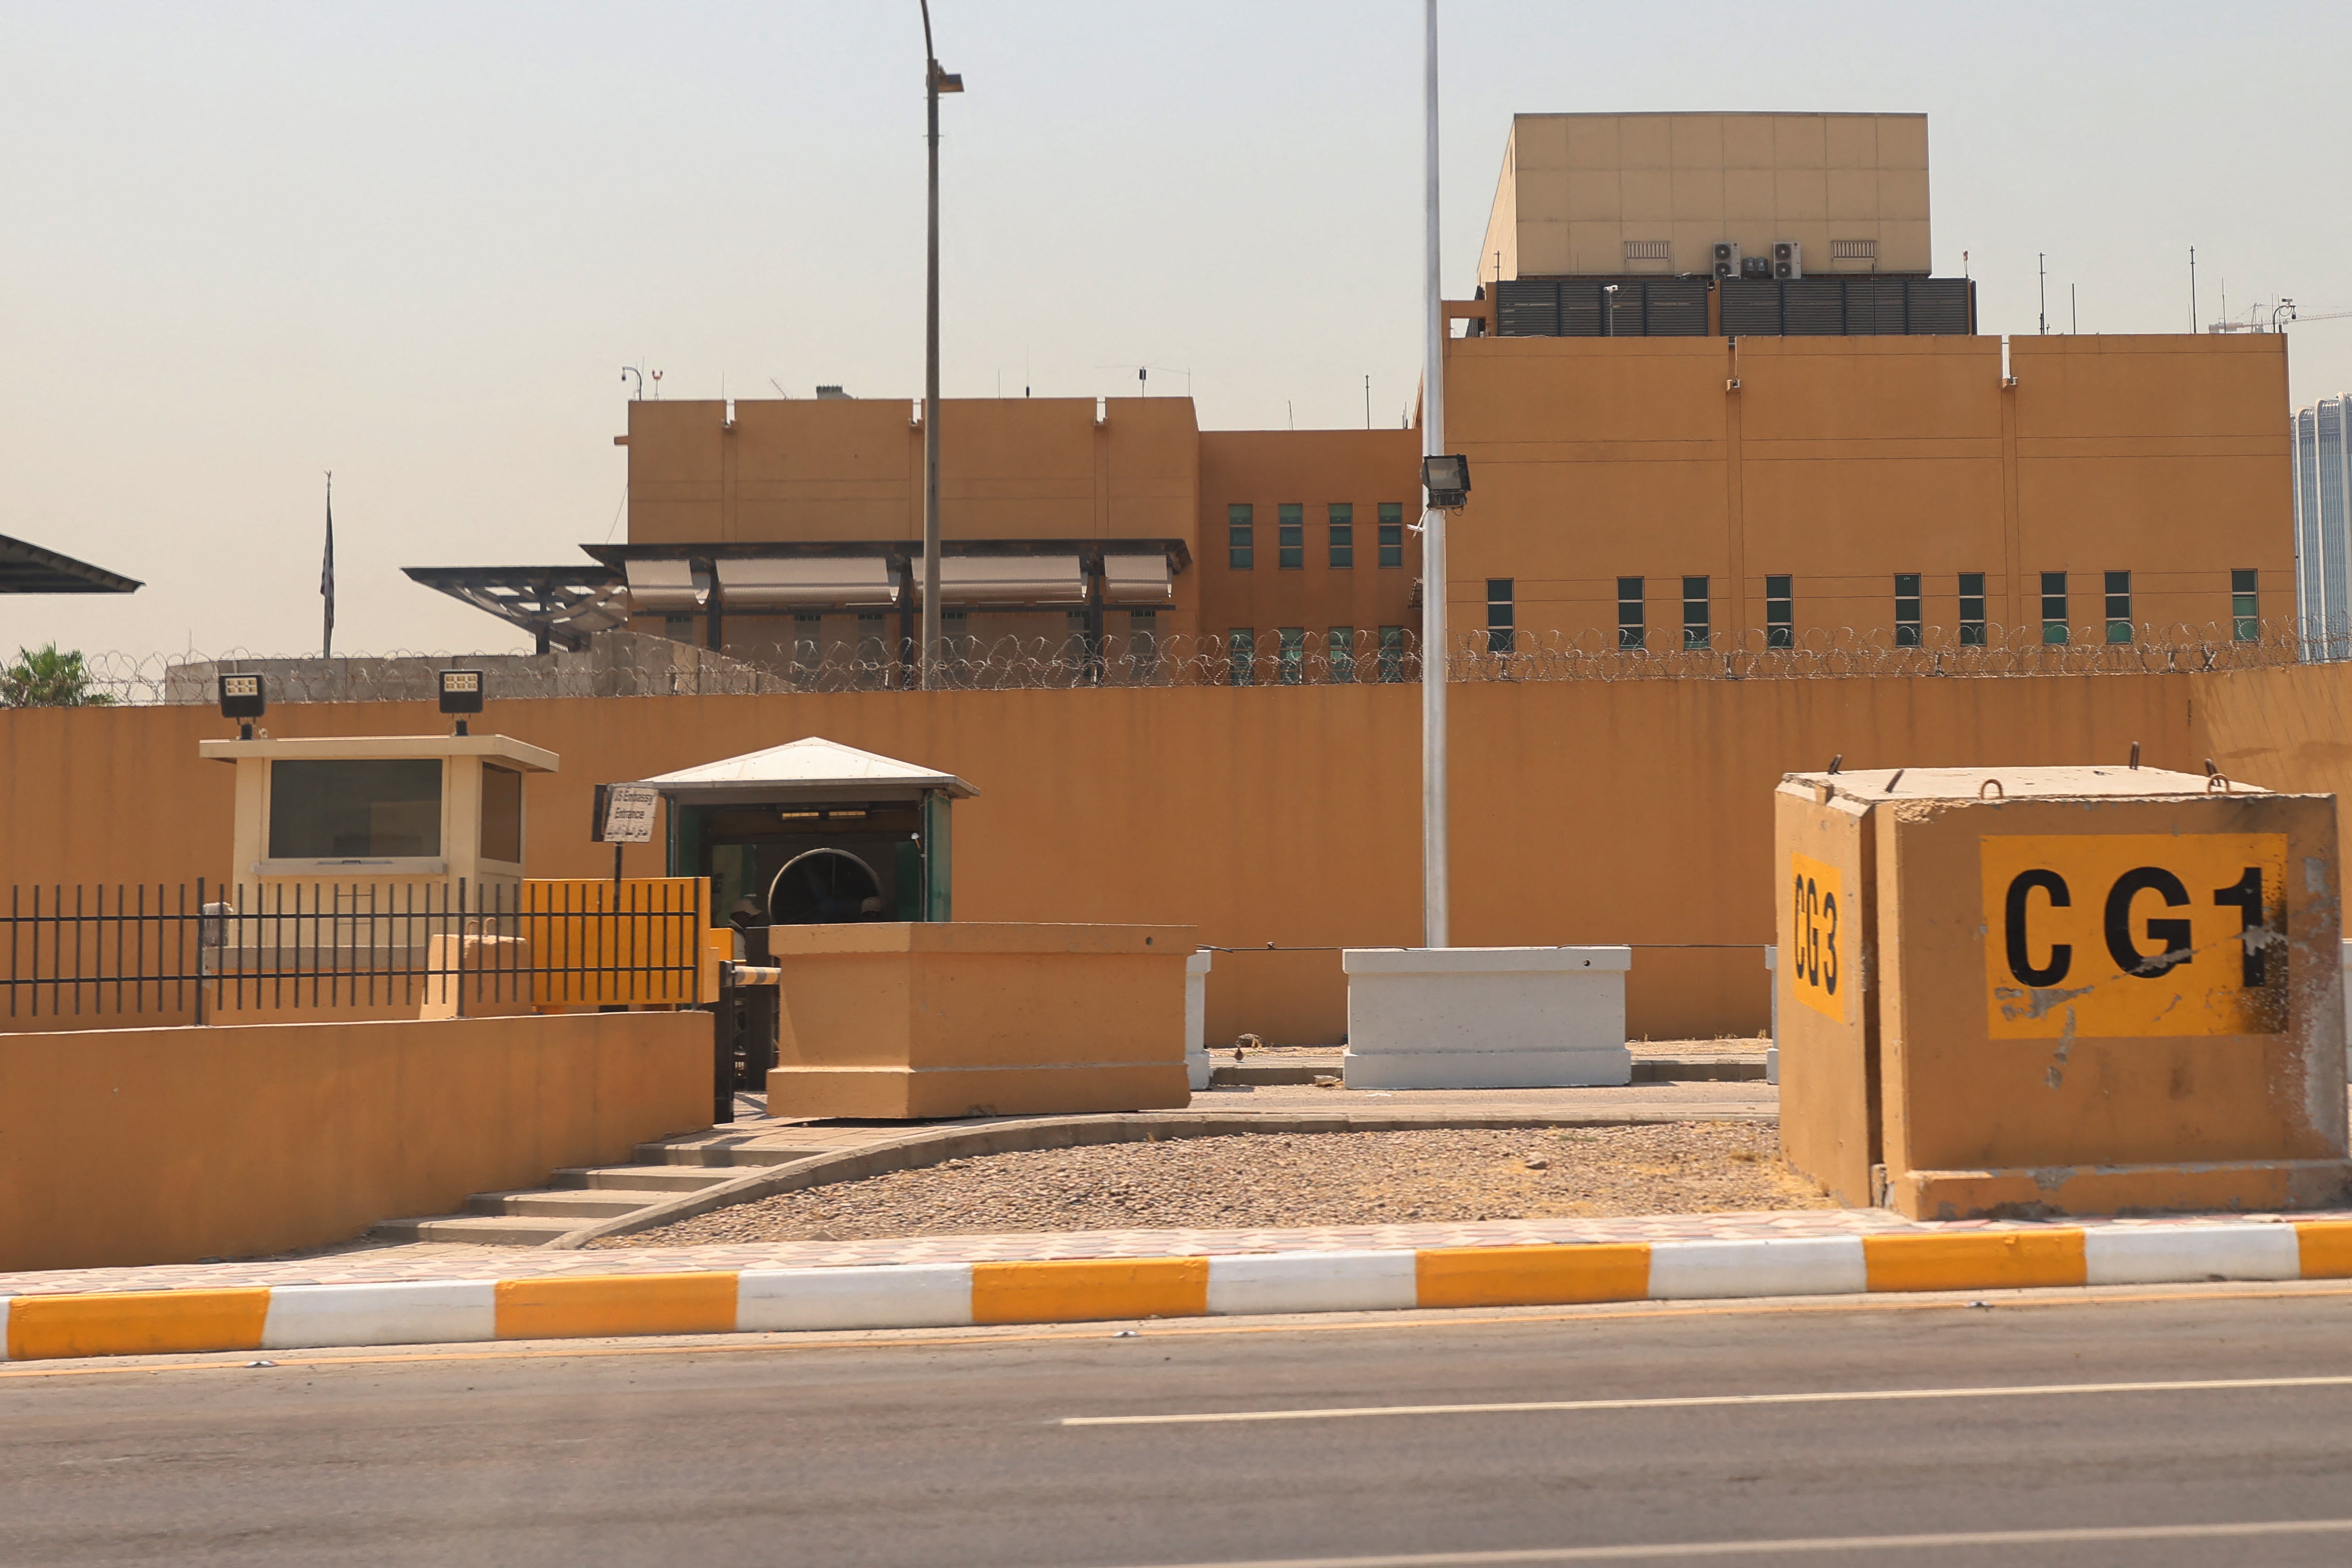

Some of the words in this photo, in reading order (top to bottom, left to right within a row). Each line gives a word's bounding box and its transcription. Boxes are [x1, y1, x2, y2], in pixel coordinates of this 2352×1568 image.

[624, 790, 653, 806] Embassy
[614, 807, 645, 819] Entrance
[1794, 872, 1839, 997] CG3
